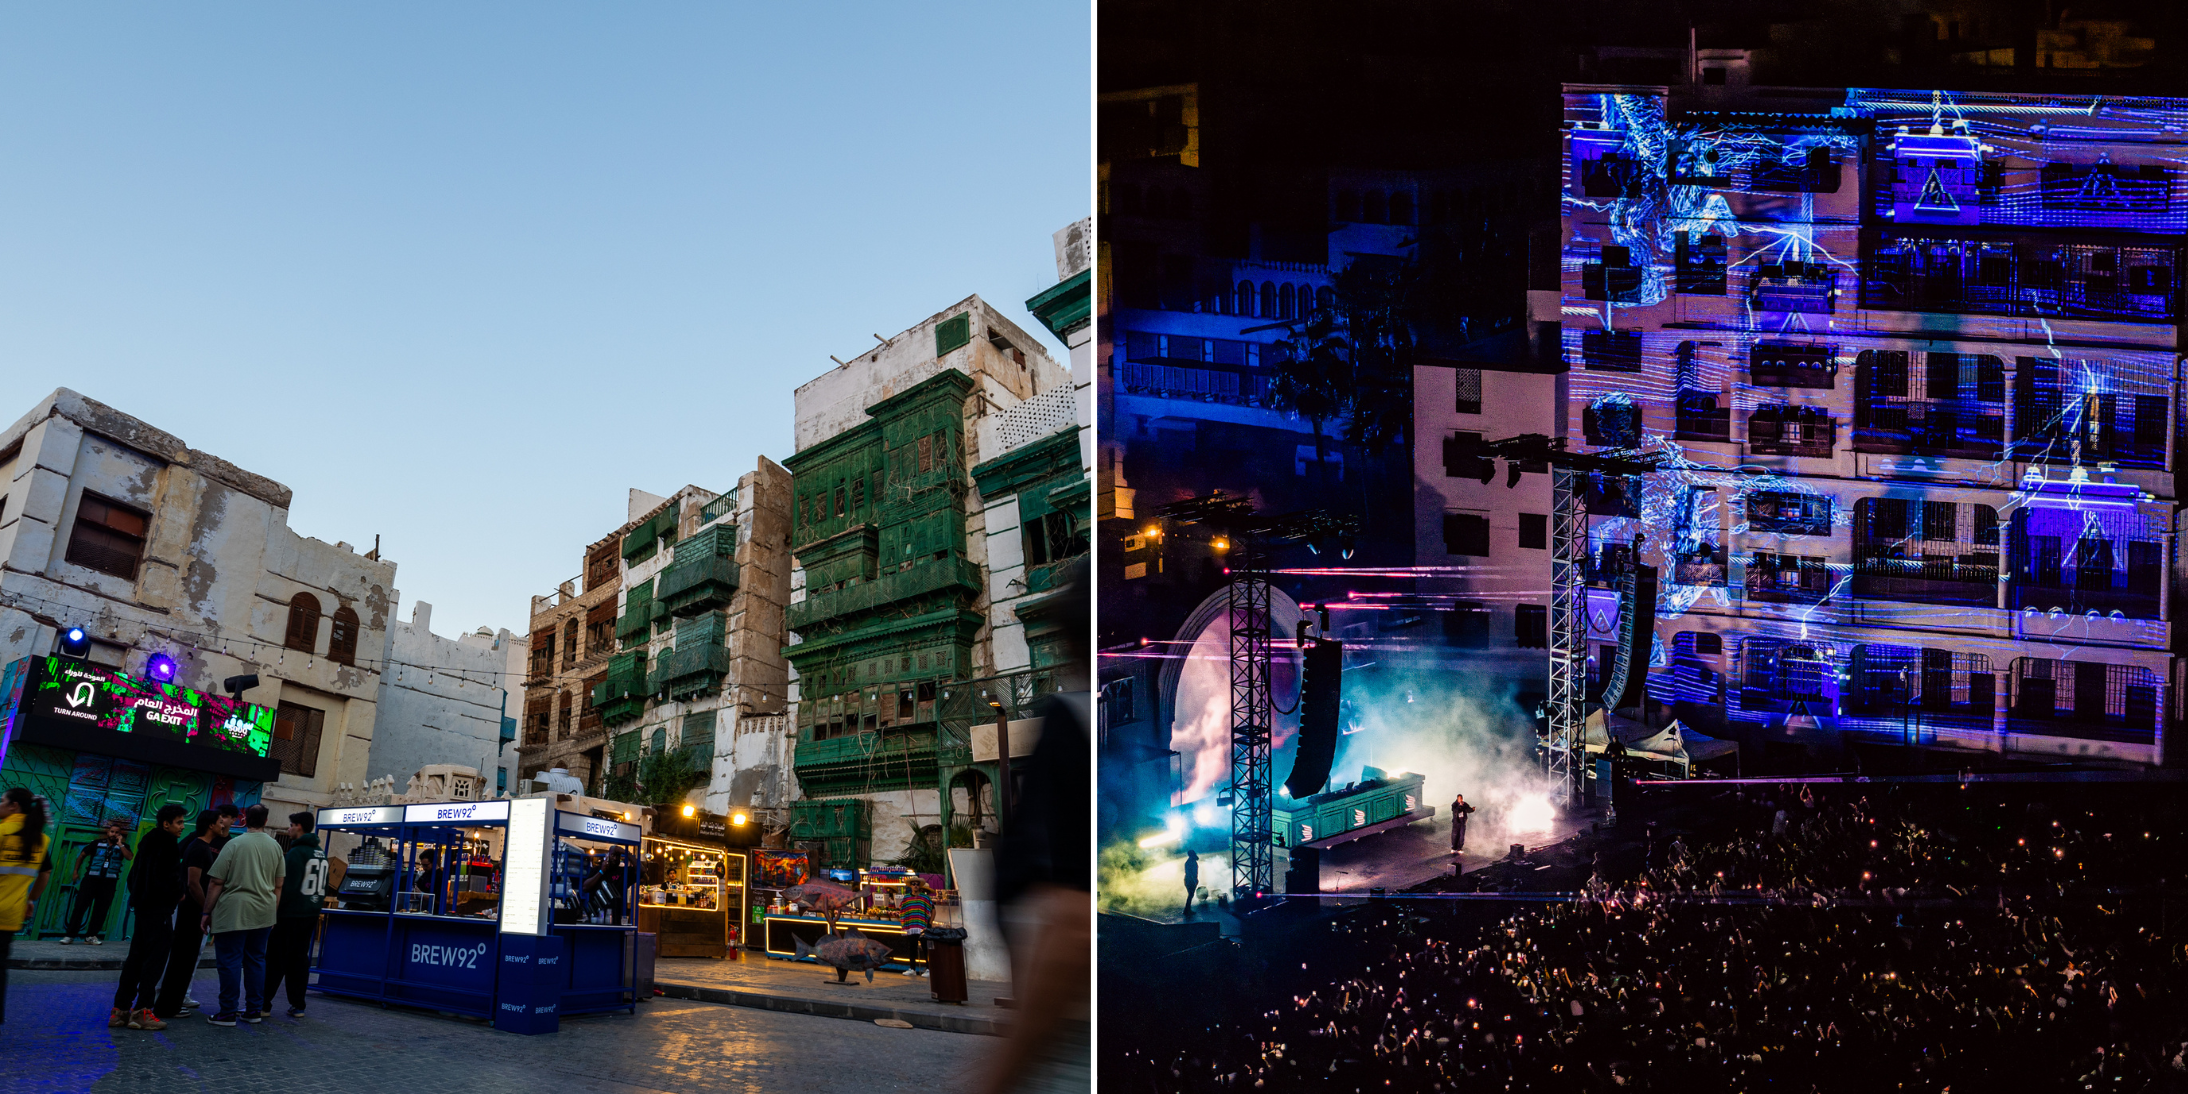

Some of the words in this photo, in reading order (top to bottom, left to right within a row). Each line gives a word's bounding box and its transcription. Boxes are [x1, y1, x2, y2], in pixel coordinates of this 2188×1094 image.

[64, 669, 83, 677] للوراء
[83, 673, 106, 682] العودة
[134, 698, 163, 709] العام
[54, 706, 71, 716] TURN
[71, 711, 97, 720] AROUND
[163, 704, 198, 717] المخرج
[146, 711, 160, 721] GA
[161, 714, 182, 725] EXIT
[300, 858, 329, 896] 60
